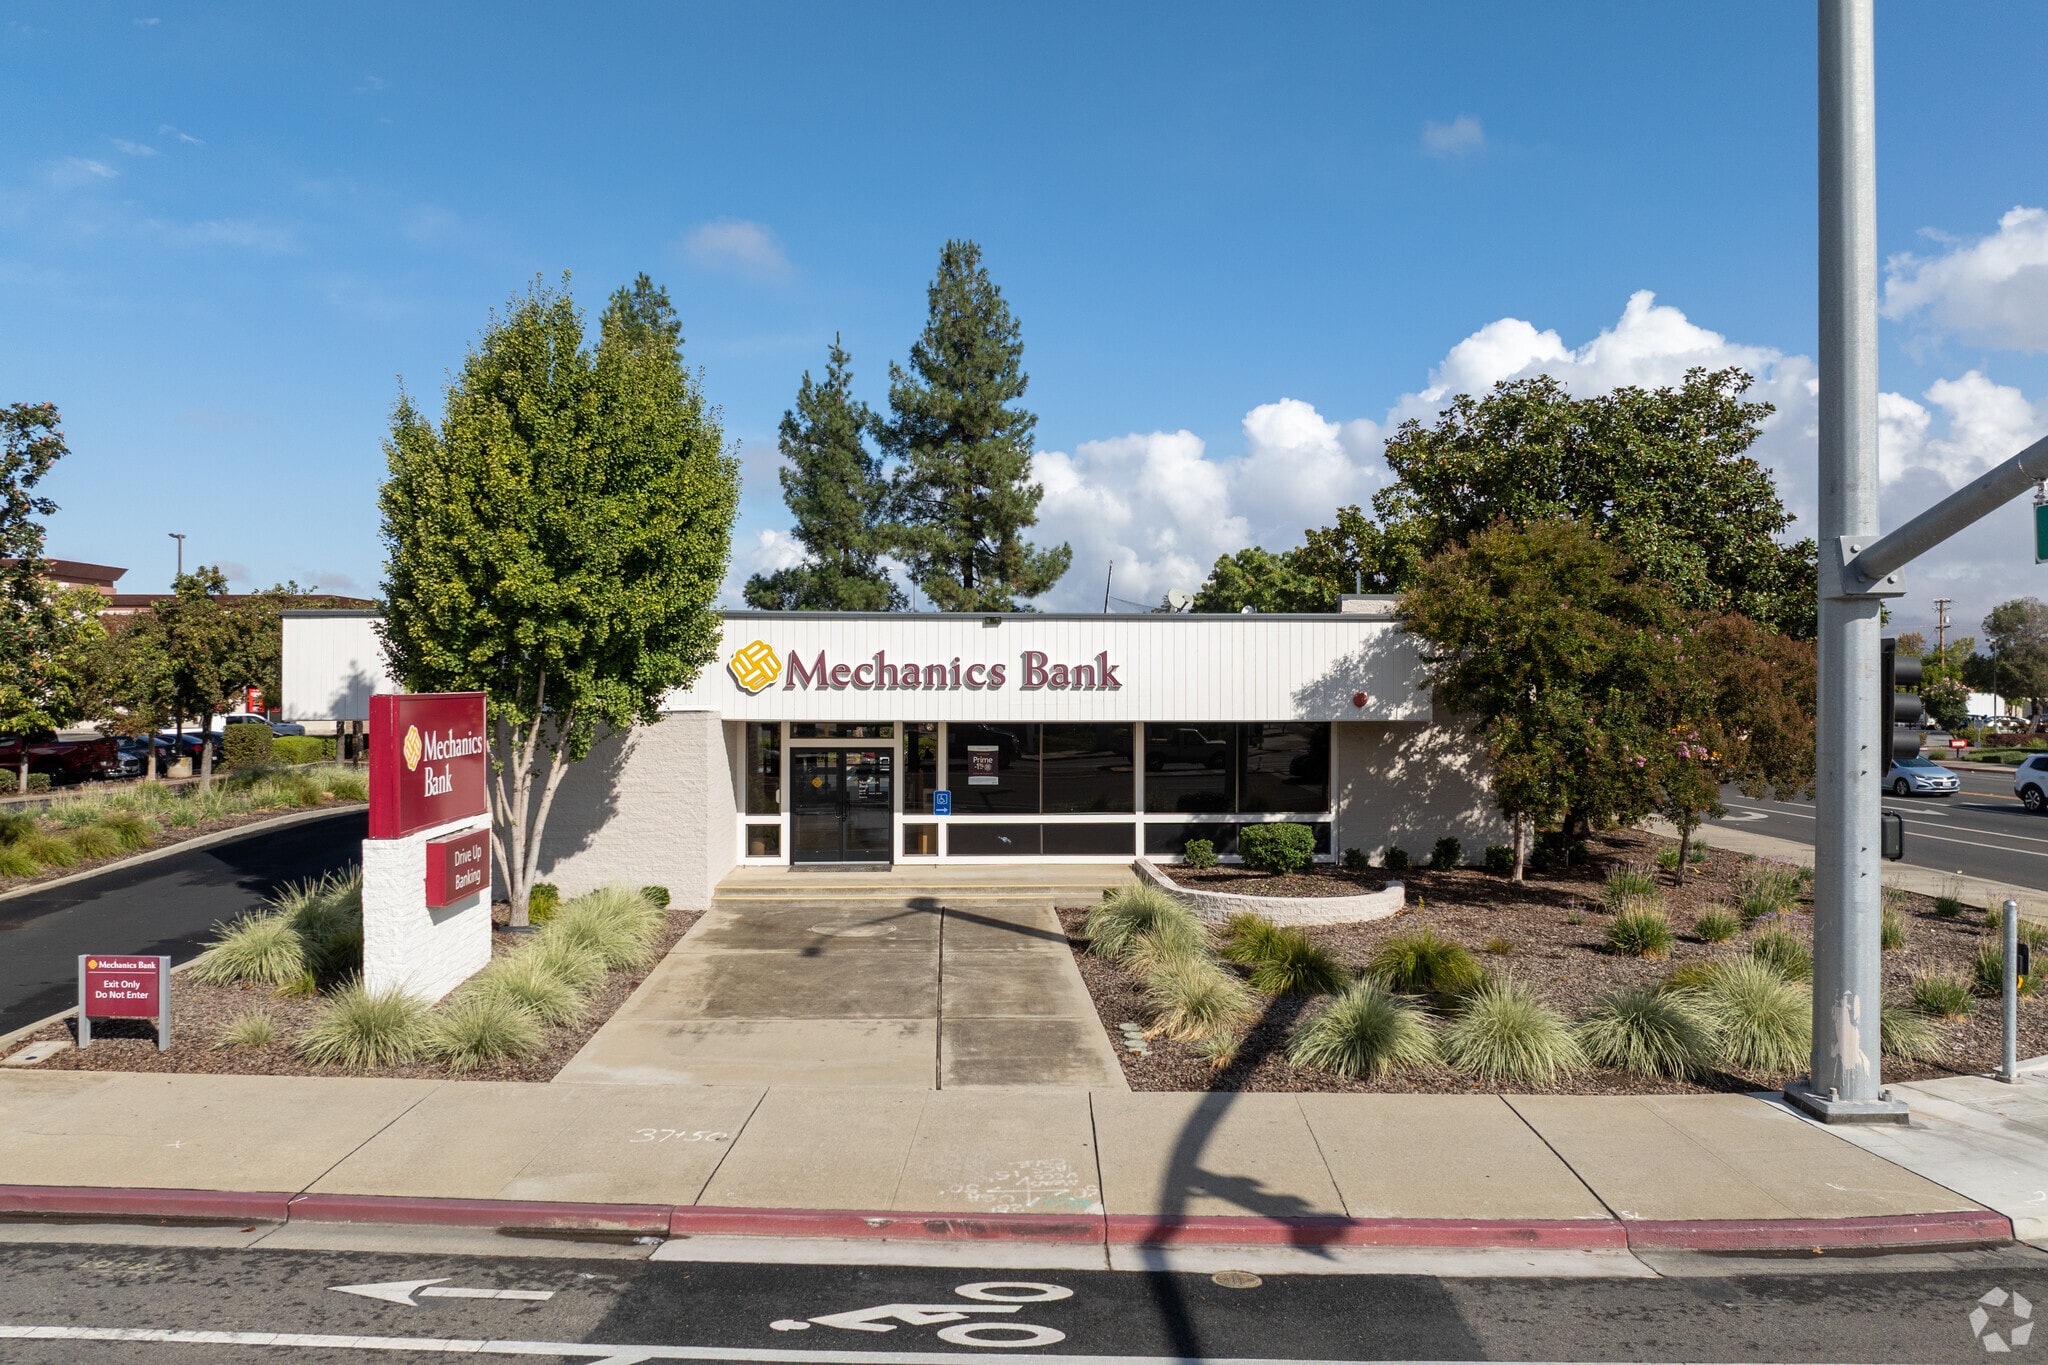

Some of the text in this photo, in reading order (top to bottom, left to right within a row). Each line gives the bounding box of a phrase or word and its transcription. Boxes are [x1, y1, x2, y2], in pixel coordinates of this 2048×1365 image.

[784, 649, 1122, 691] Mechanics Bank
[423, 728, 483, 762] Mechanics
[424, 764, 453, 798] Bank
[454, 844, 482, 867] Drive Up
[455, 869, 481, 890] Banking
[99, 961, 156, 969] Mechanics Bank
[95, 991, 149, 999] Do Not Enter
[104, 980, 140, 989] Exit Only
